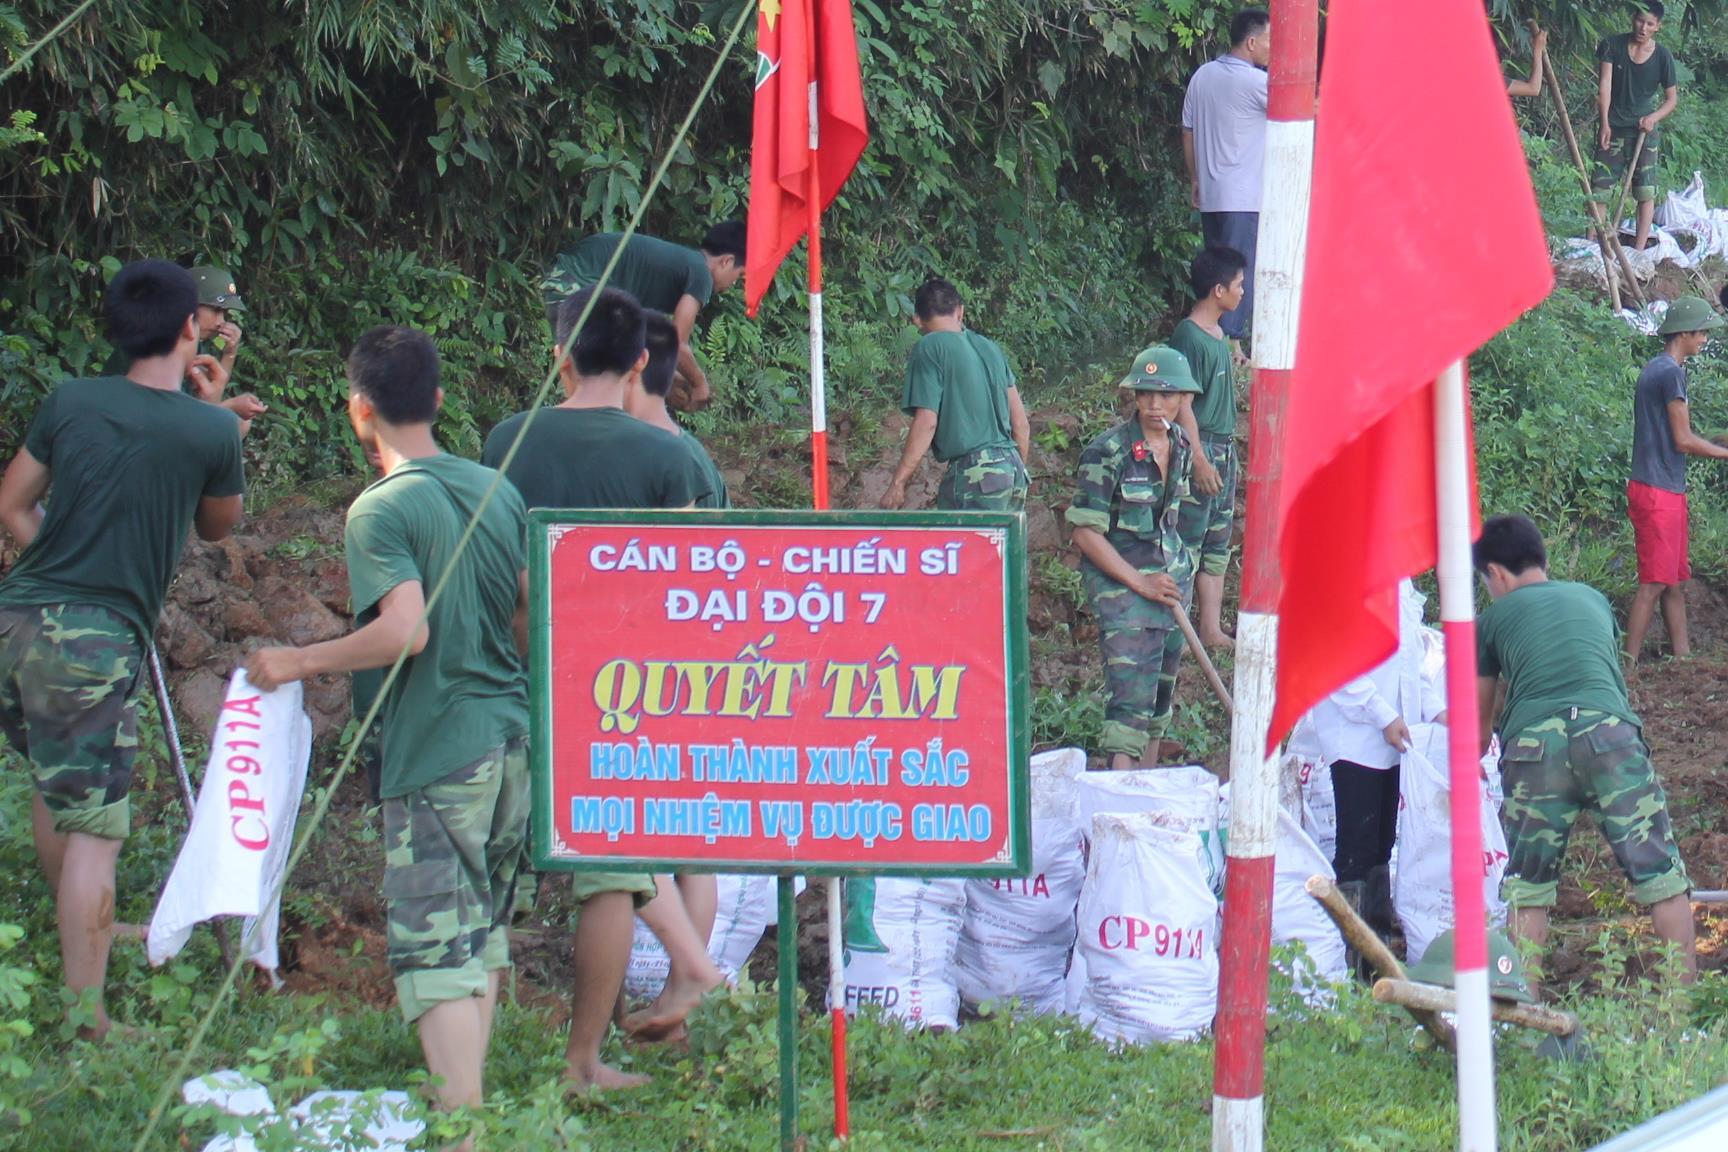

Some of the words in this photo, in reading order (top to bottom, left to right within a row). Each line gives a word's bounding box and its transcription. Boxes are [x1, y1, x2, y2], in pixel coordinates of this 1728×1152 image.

[589, 538, 677, 573] CÁN
[690, 540, 746, 580] BỘ
[782, 537, 907, 575] CHIẾN
[919, 543, 963, 575] SĨ
[664, 588, 748, 631] ĐẠI
[760, 582, 845, 632] ĐỘI
[859, 592, 887, 624] 7
[592, 633, 806, 735] QUYẾT
[821, 644, 967, 721] TÂM
[590, 736, 681, 782] HOÀN
[688, 737, 798, 784] THÀNH
[804, 736, 893, 787] XUẤT
[900, 737, 970, 787] SẮC
[570, 796, 635, 843] MỌI
[643, 791, 752, 845] NHIỆM
[759, 799, 804, 846] VỤ
[811, 798, 903, 848] ĐƯỢC
[911, 804, 992, 842] GIAO
